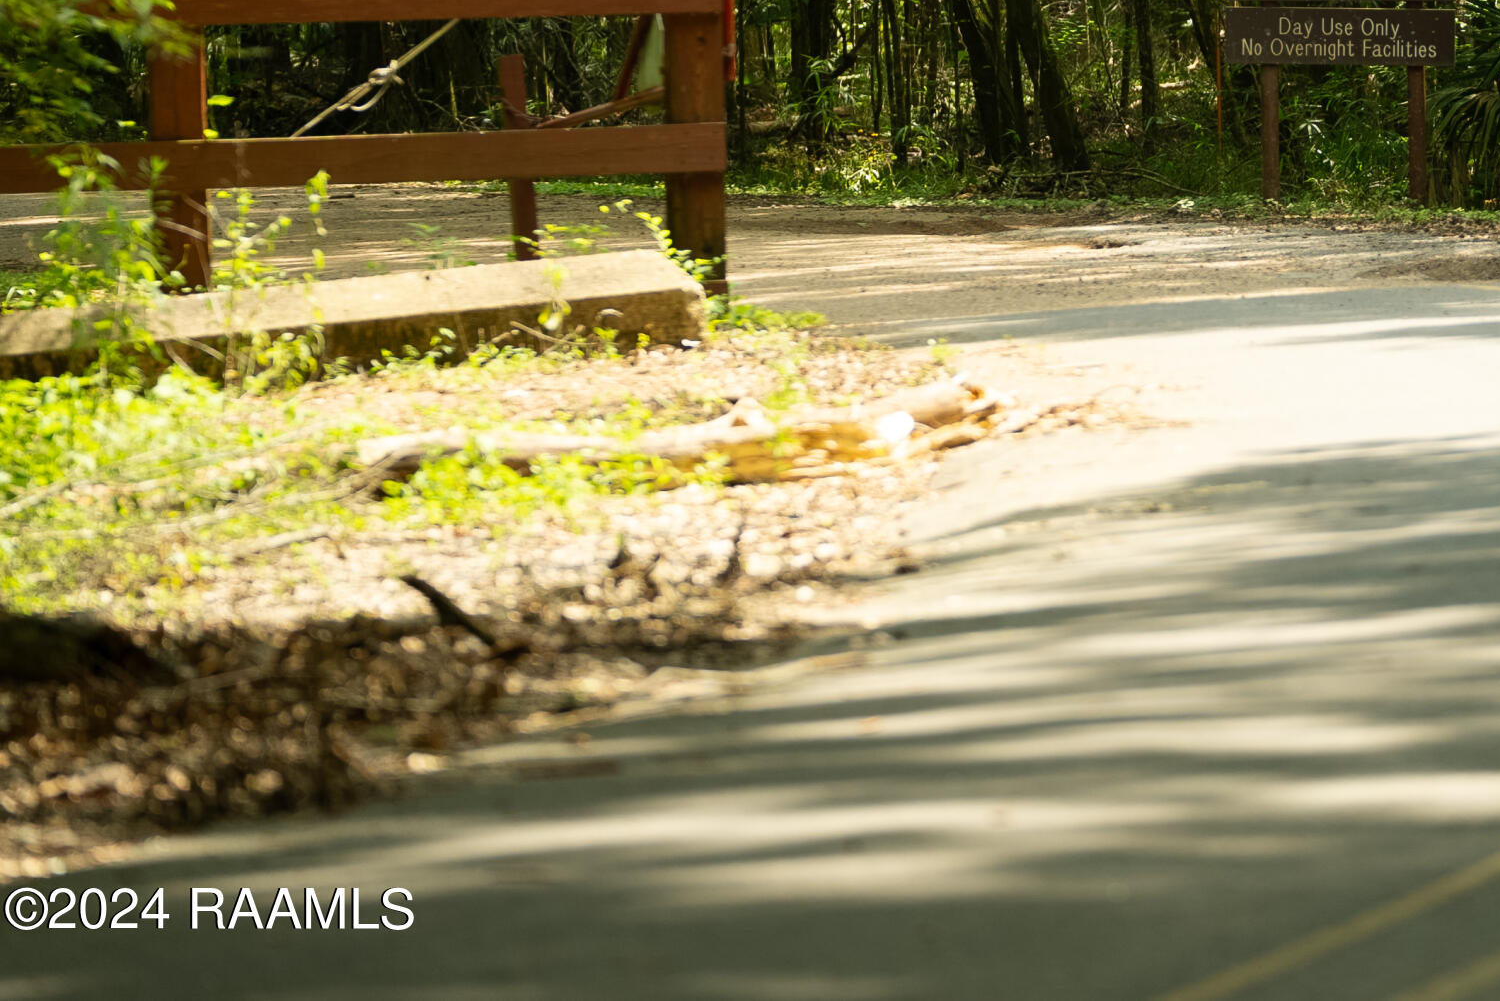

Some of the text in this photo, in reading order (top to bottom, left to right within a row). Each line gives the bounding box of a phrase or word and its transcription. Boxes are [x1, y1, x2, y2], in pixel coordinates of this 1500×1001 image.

[1279, 16, 1400, 40] Day Use Only
[1241, 38, 1437, 61] No Overnight Facilities
